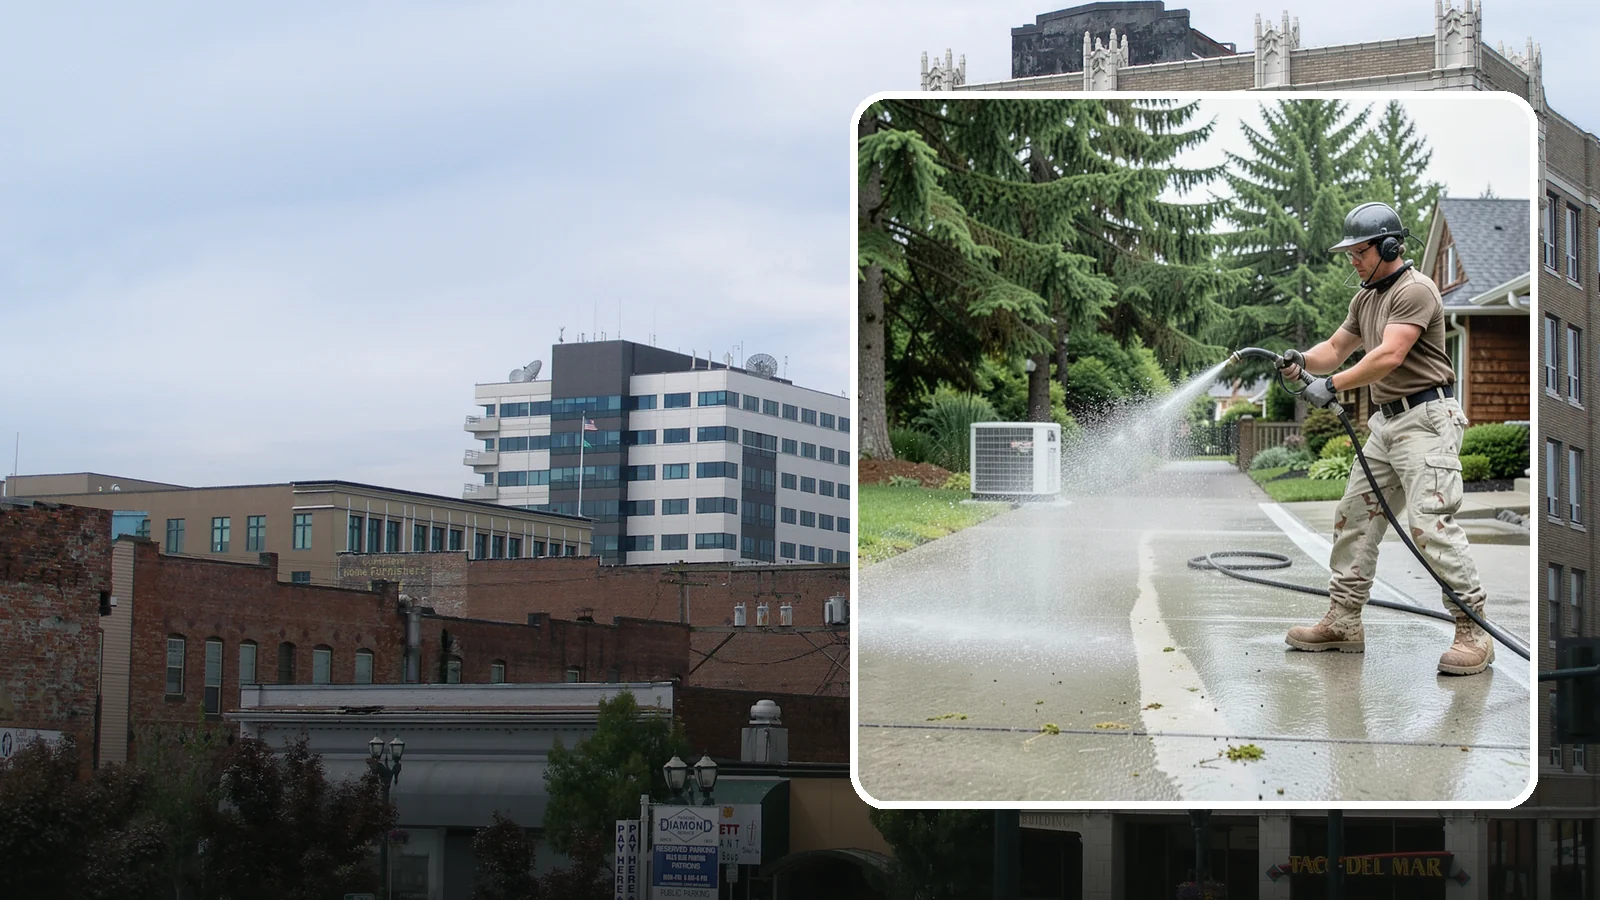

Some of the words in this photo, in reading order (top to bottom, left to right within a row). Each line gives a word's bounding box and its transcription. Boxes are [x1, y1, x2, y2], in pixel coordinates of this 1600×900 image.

[370, 565, 427, 577] Furnishers
[660, 818, 713, 833] DIAMOND
[1022, 815, 1069, 828] BUILDING
[617, 825, 625, 852] PAY
[629, 824, 637, 852] PAY
[656, 845, 688, 853] RESERVED
[689, 845, 716, 854] PARKING
[721, 851, 739, 862] Soup
[671, 862, 701, 870] PATRONS
[1290, 855, 1329, 874] TAC
[1346, 856, 1385, 875] DEL
[1392, 857, 1443, 877] MAR
[617, 855, 625, 893] HERE
[628, 855, 636, 893] HERE
[660, 889, 682, 897] PUBLIC
[683, 889, 710, 898] PARKING
